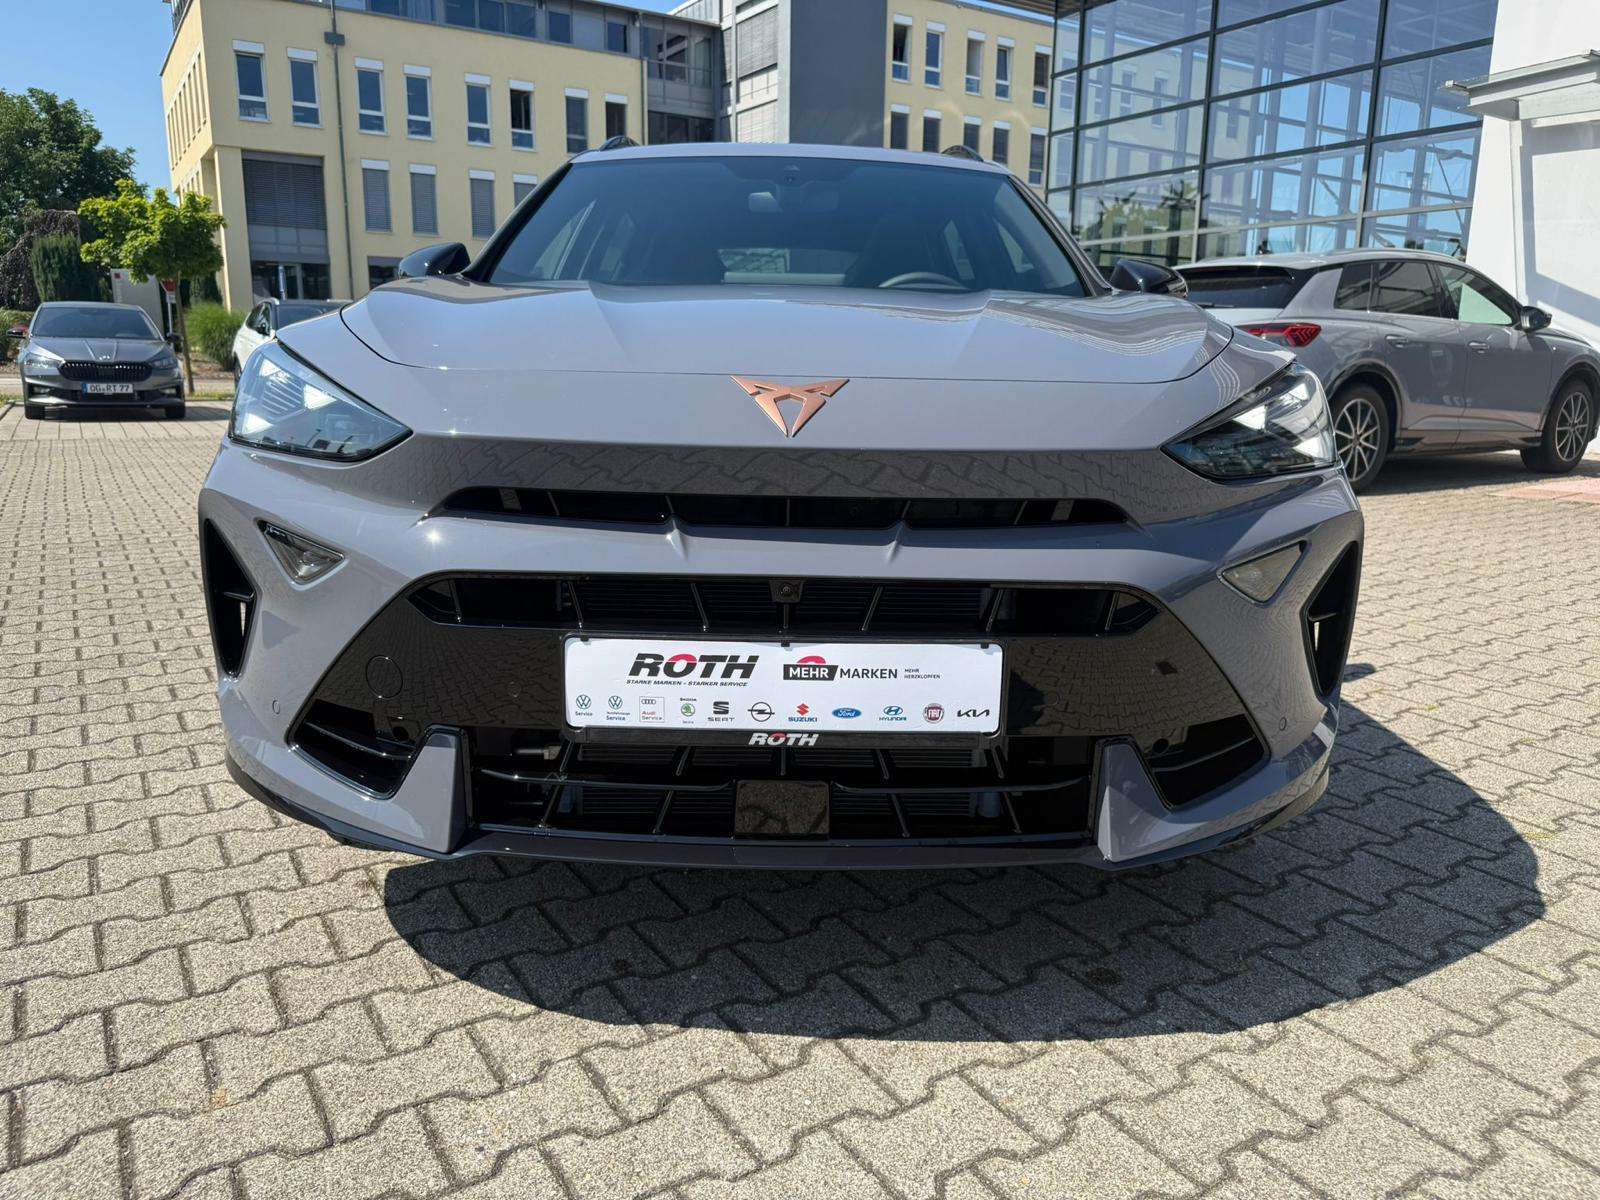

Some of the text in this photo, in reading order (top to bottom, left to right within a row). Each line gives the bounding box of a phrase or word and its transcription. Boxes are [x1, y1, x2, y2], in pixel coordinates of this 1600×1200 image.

[629, 653, 759, 679] ROTH
[789, 667, 898, 679] MEHR MARKEN
[838, 709, 856, 717] Ford
[957, 708, 990, 718] KIA
[748, 731, 819, 746] ROTH
